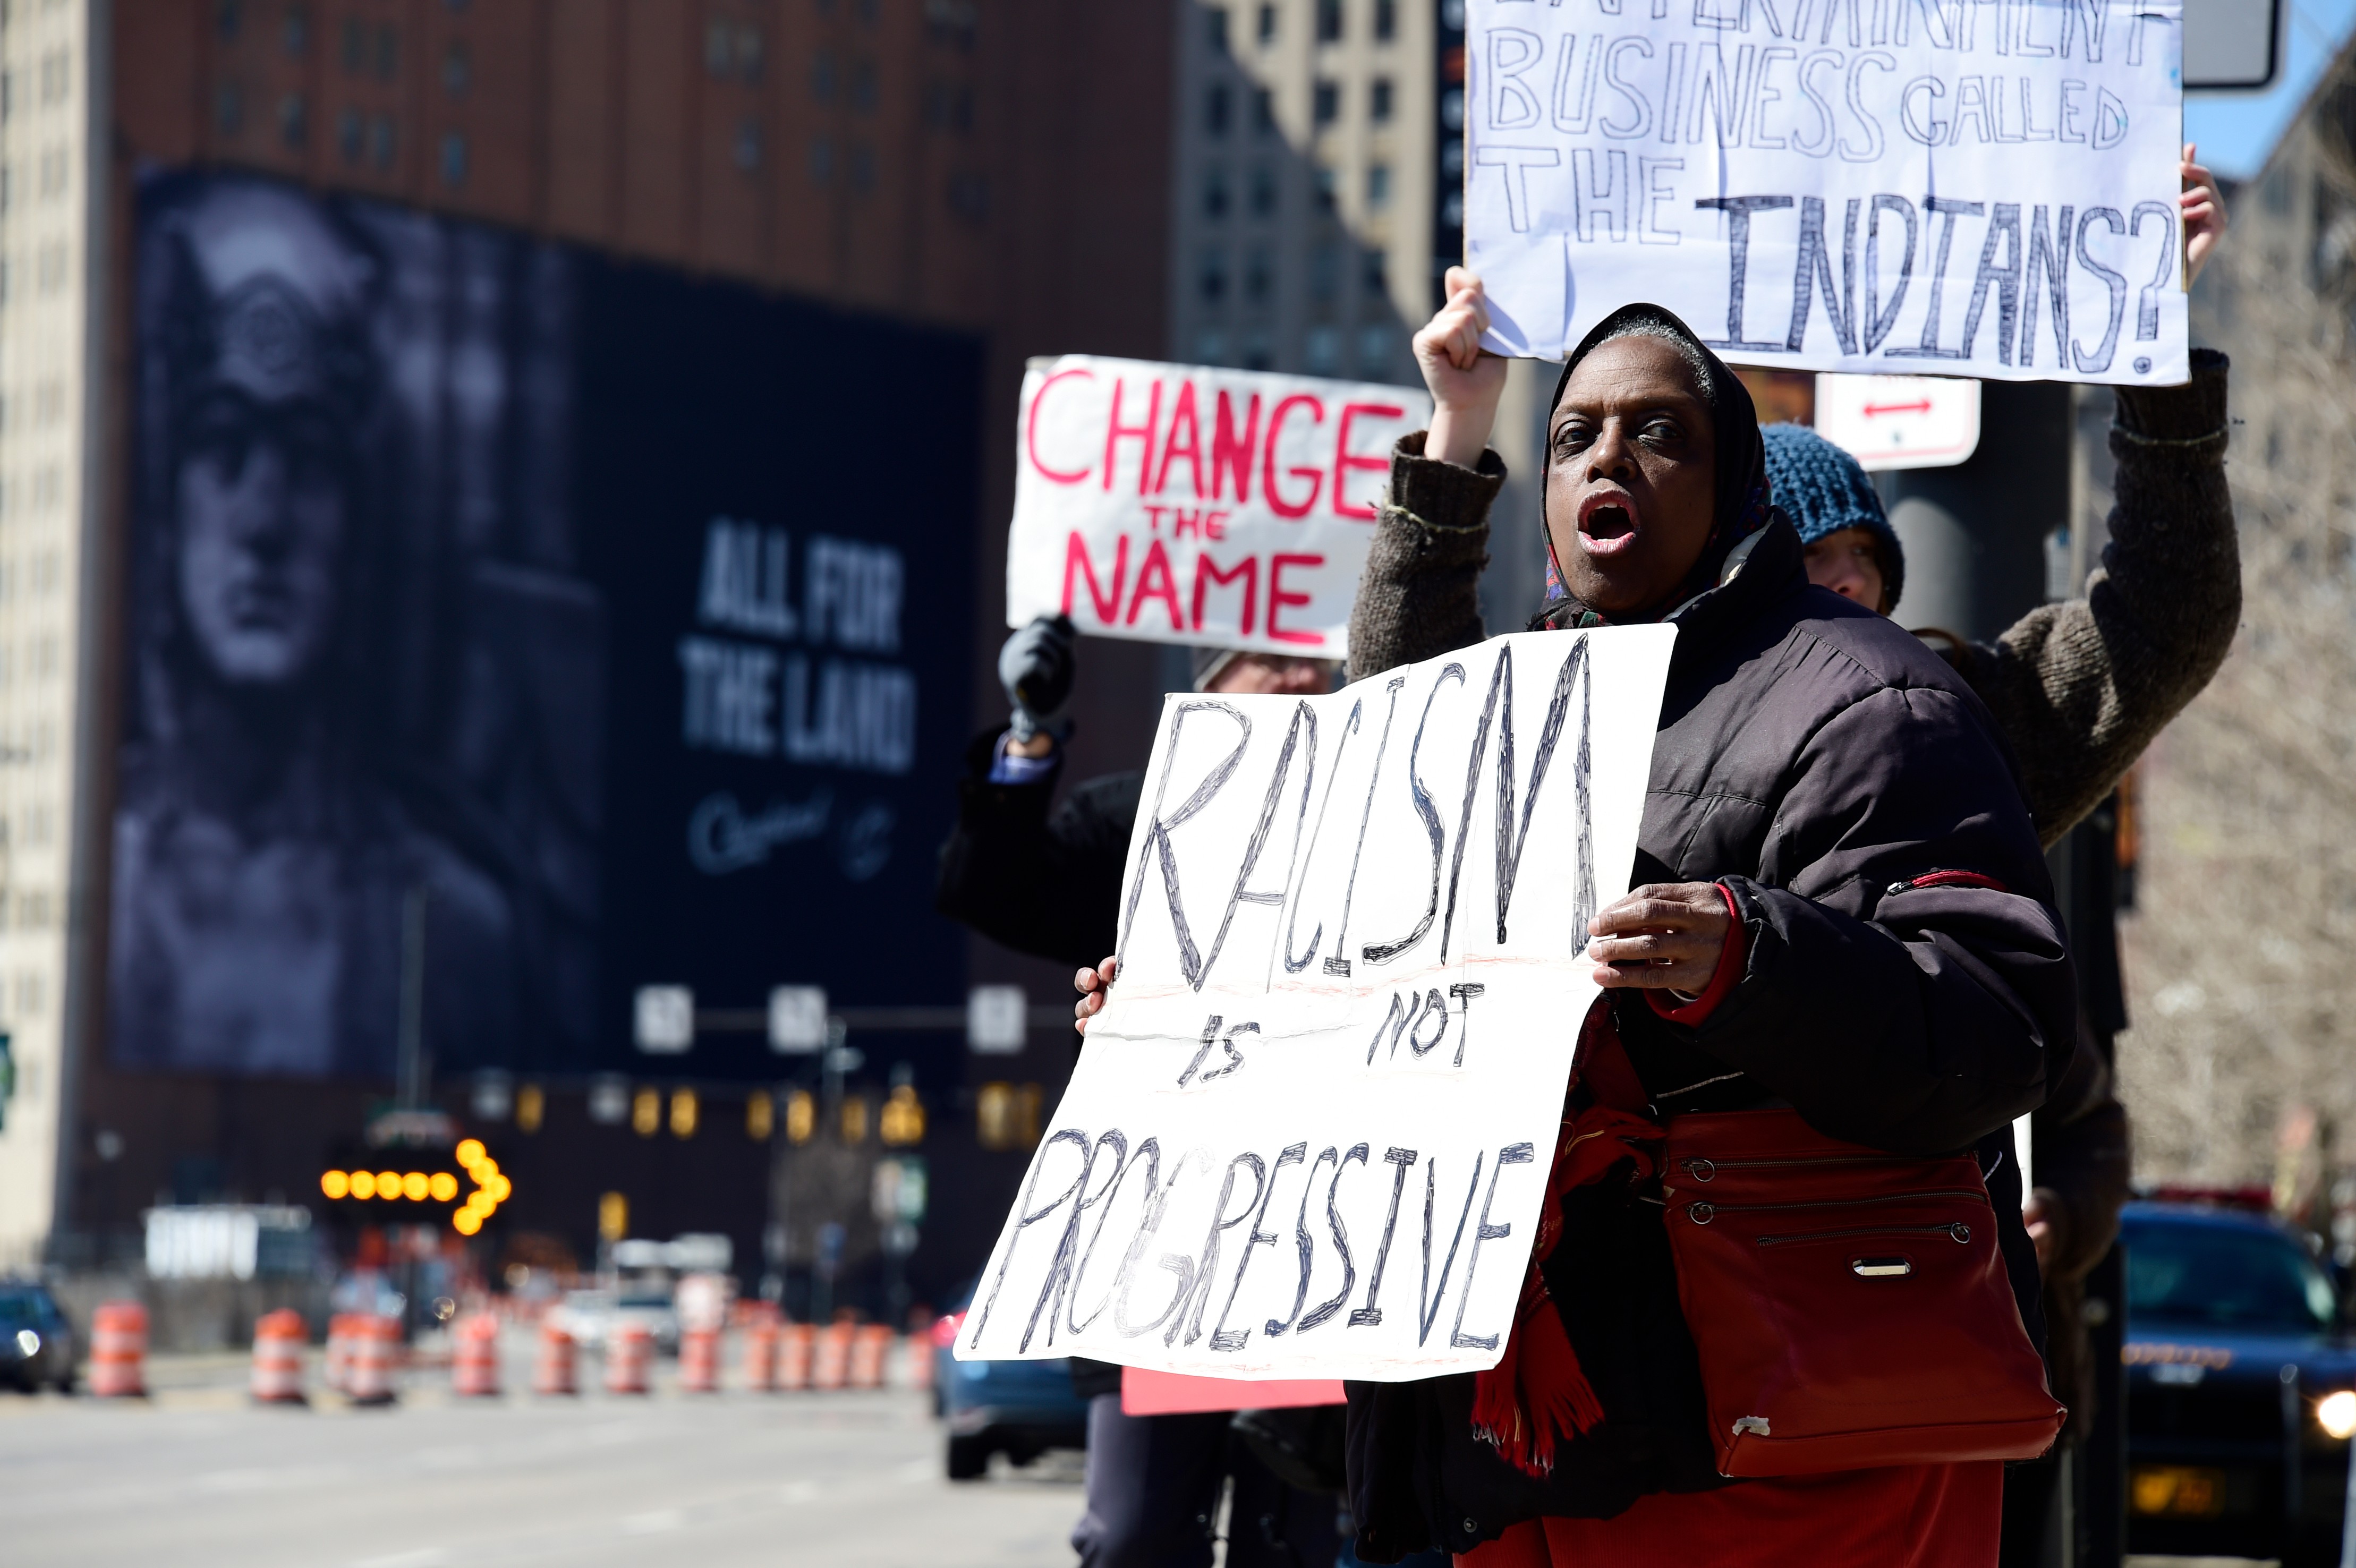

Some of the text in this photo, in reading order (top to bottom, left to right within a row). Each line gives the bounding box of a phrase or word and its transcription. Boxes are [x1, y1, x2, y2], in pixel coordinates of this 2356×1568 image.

[1486, 27, 2128, 163] BUSINESS CALLED
[1476, 146, 2175, 373] THE INDIANS?
[1027, 369, 1404, 521] CHANGE
[700, 518, 905, 652] ALL FOR
[1062, 531, 1325, 644] NAME
[1143, 505, 1231, 542] THE
[680, 636, 917, 773] THE LAND
[1113, 632, 1597, 994] RACISM
[1176, 982, 1485, 1089] IS NOT
[971, 1128, 1533, 1354] PROGRESSIVE
